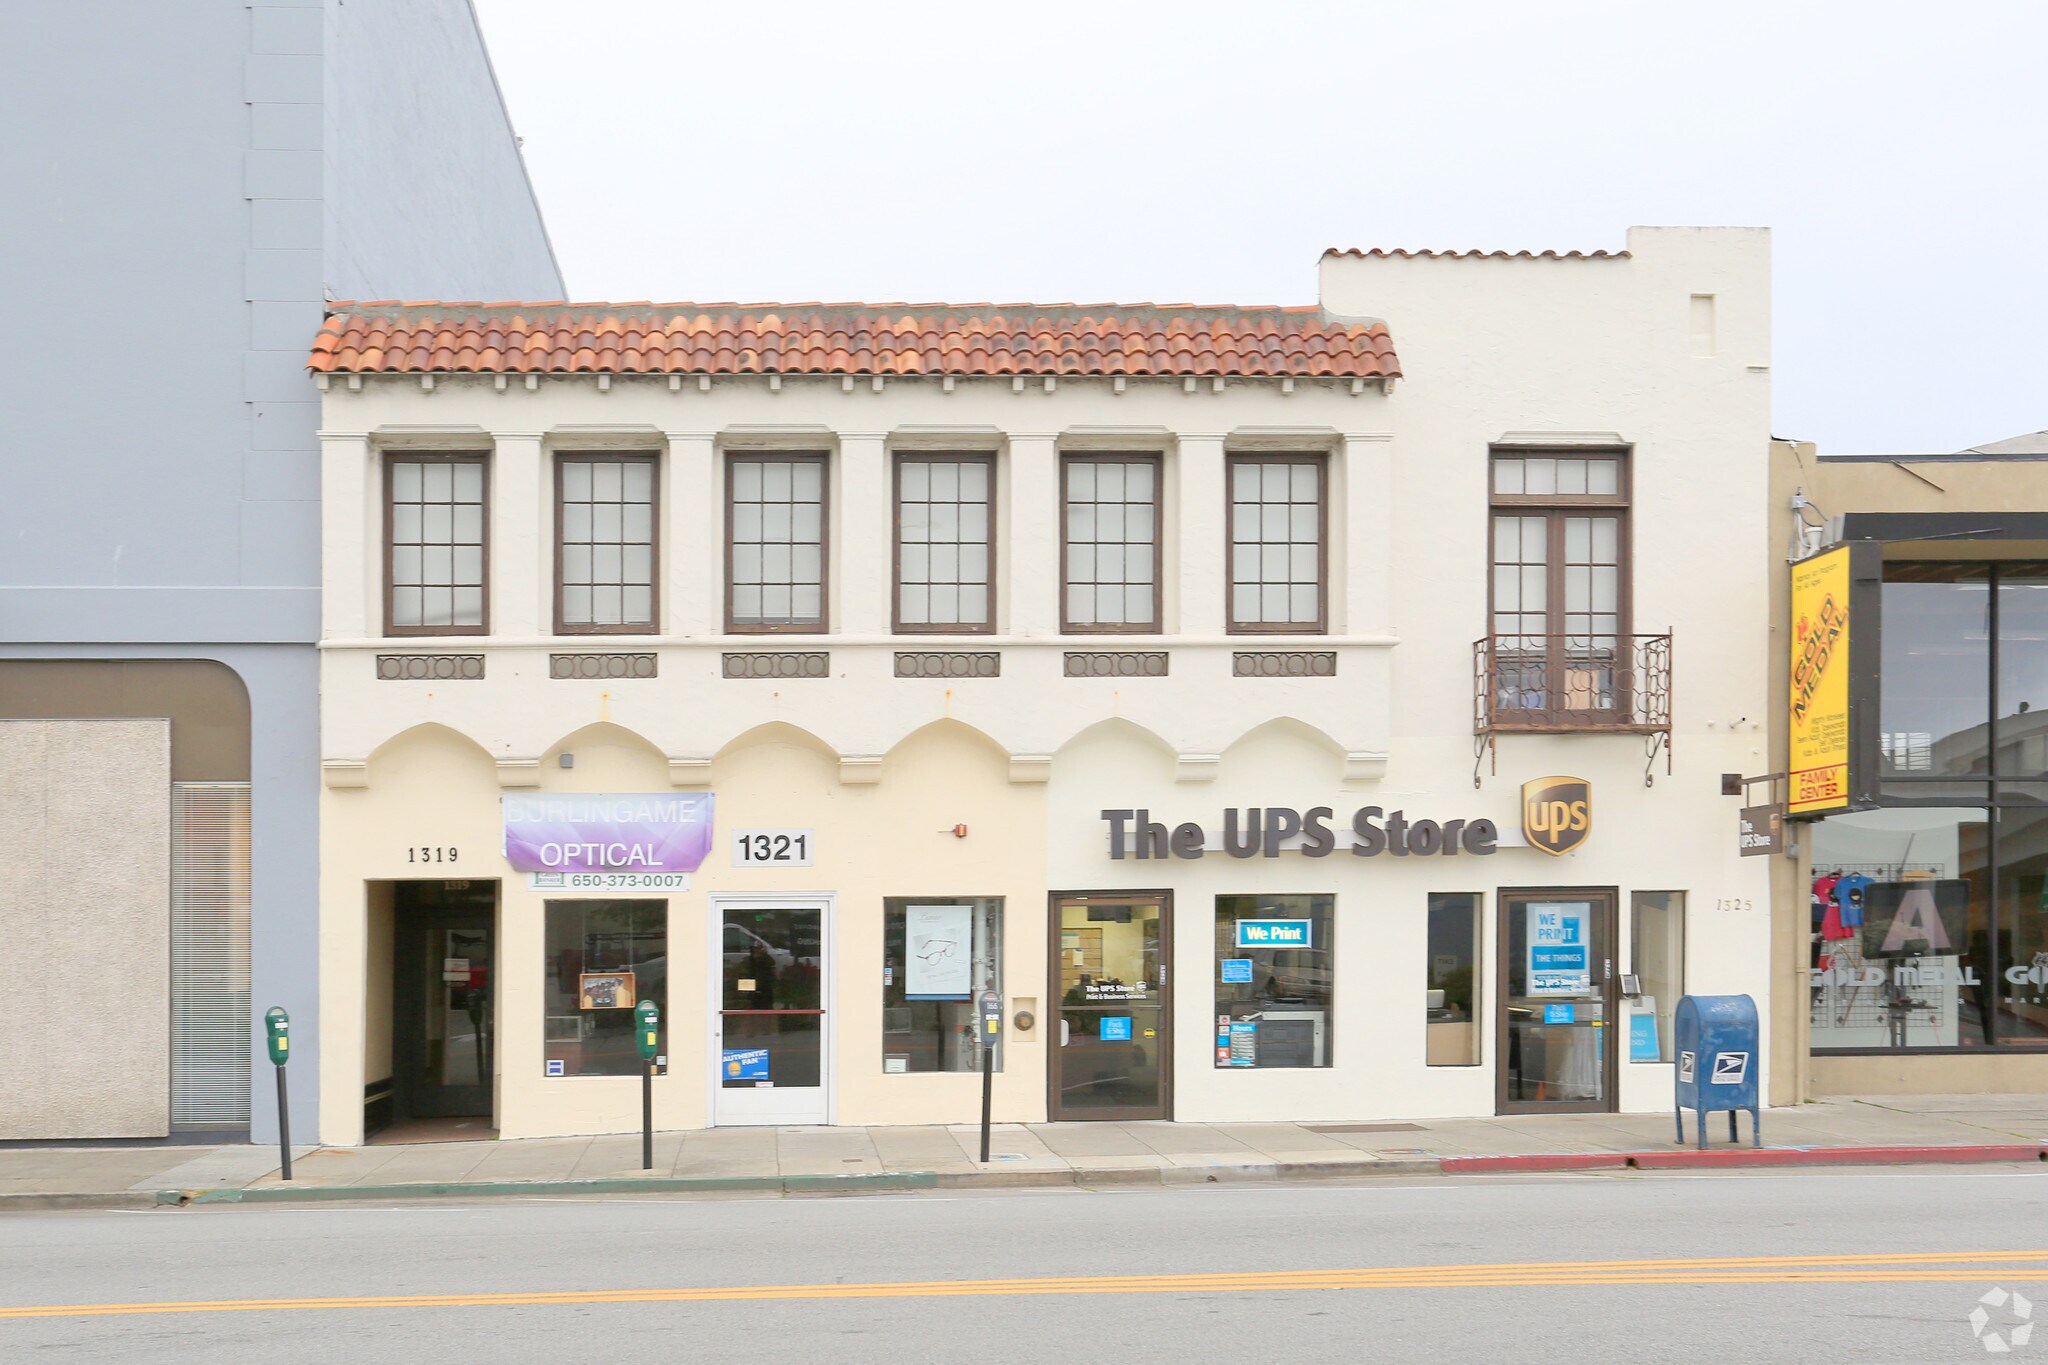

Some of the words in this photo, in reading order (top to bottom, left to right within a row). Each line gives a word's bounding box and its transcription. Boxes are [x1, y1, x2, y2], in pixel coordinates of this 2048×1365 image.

[1800, 768, 1838, 786] FAMILY
[1799, 782, 1837, 800] CENTER
[507, 800, 697, 823] BURLINGAME
[1529, 800, 1587, 844] ups
[1740, 819, 1753, 833] The
[1101, 808, 1205, 860] The
[1223, 806, 1336, 859] UPS
[1351, 805, 1499, 856] Store
[738, 834, 805, 861] 1321
[408, 847, 458, 863] 1319
[539, 843, 663, 867] OPTICAL
[444, 880, 470, 890] 1319
[572, 874, 684, 887] 650-373-0007
[1539, 913, 1556, 925] WE
[1246, 926, 1269, 940] We
[1270, 926, 1303, 940] Print
[1538, 927, 1574, 940] PRINT
[1536, 954, 1552, 963] THE
[1553, 953, 1582, 962] THINGS
[1100, 984, 1116, 992] UPS
[1115, 984, 1135, 992] Store
[722, 1049, 768, 1063] AUTHENTIC
[741, 1057, 759, 1066] FAN
